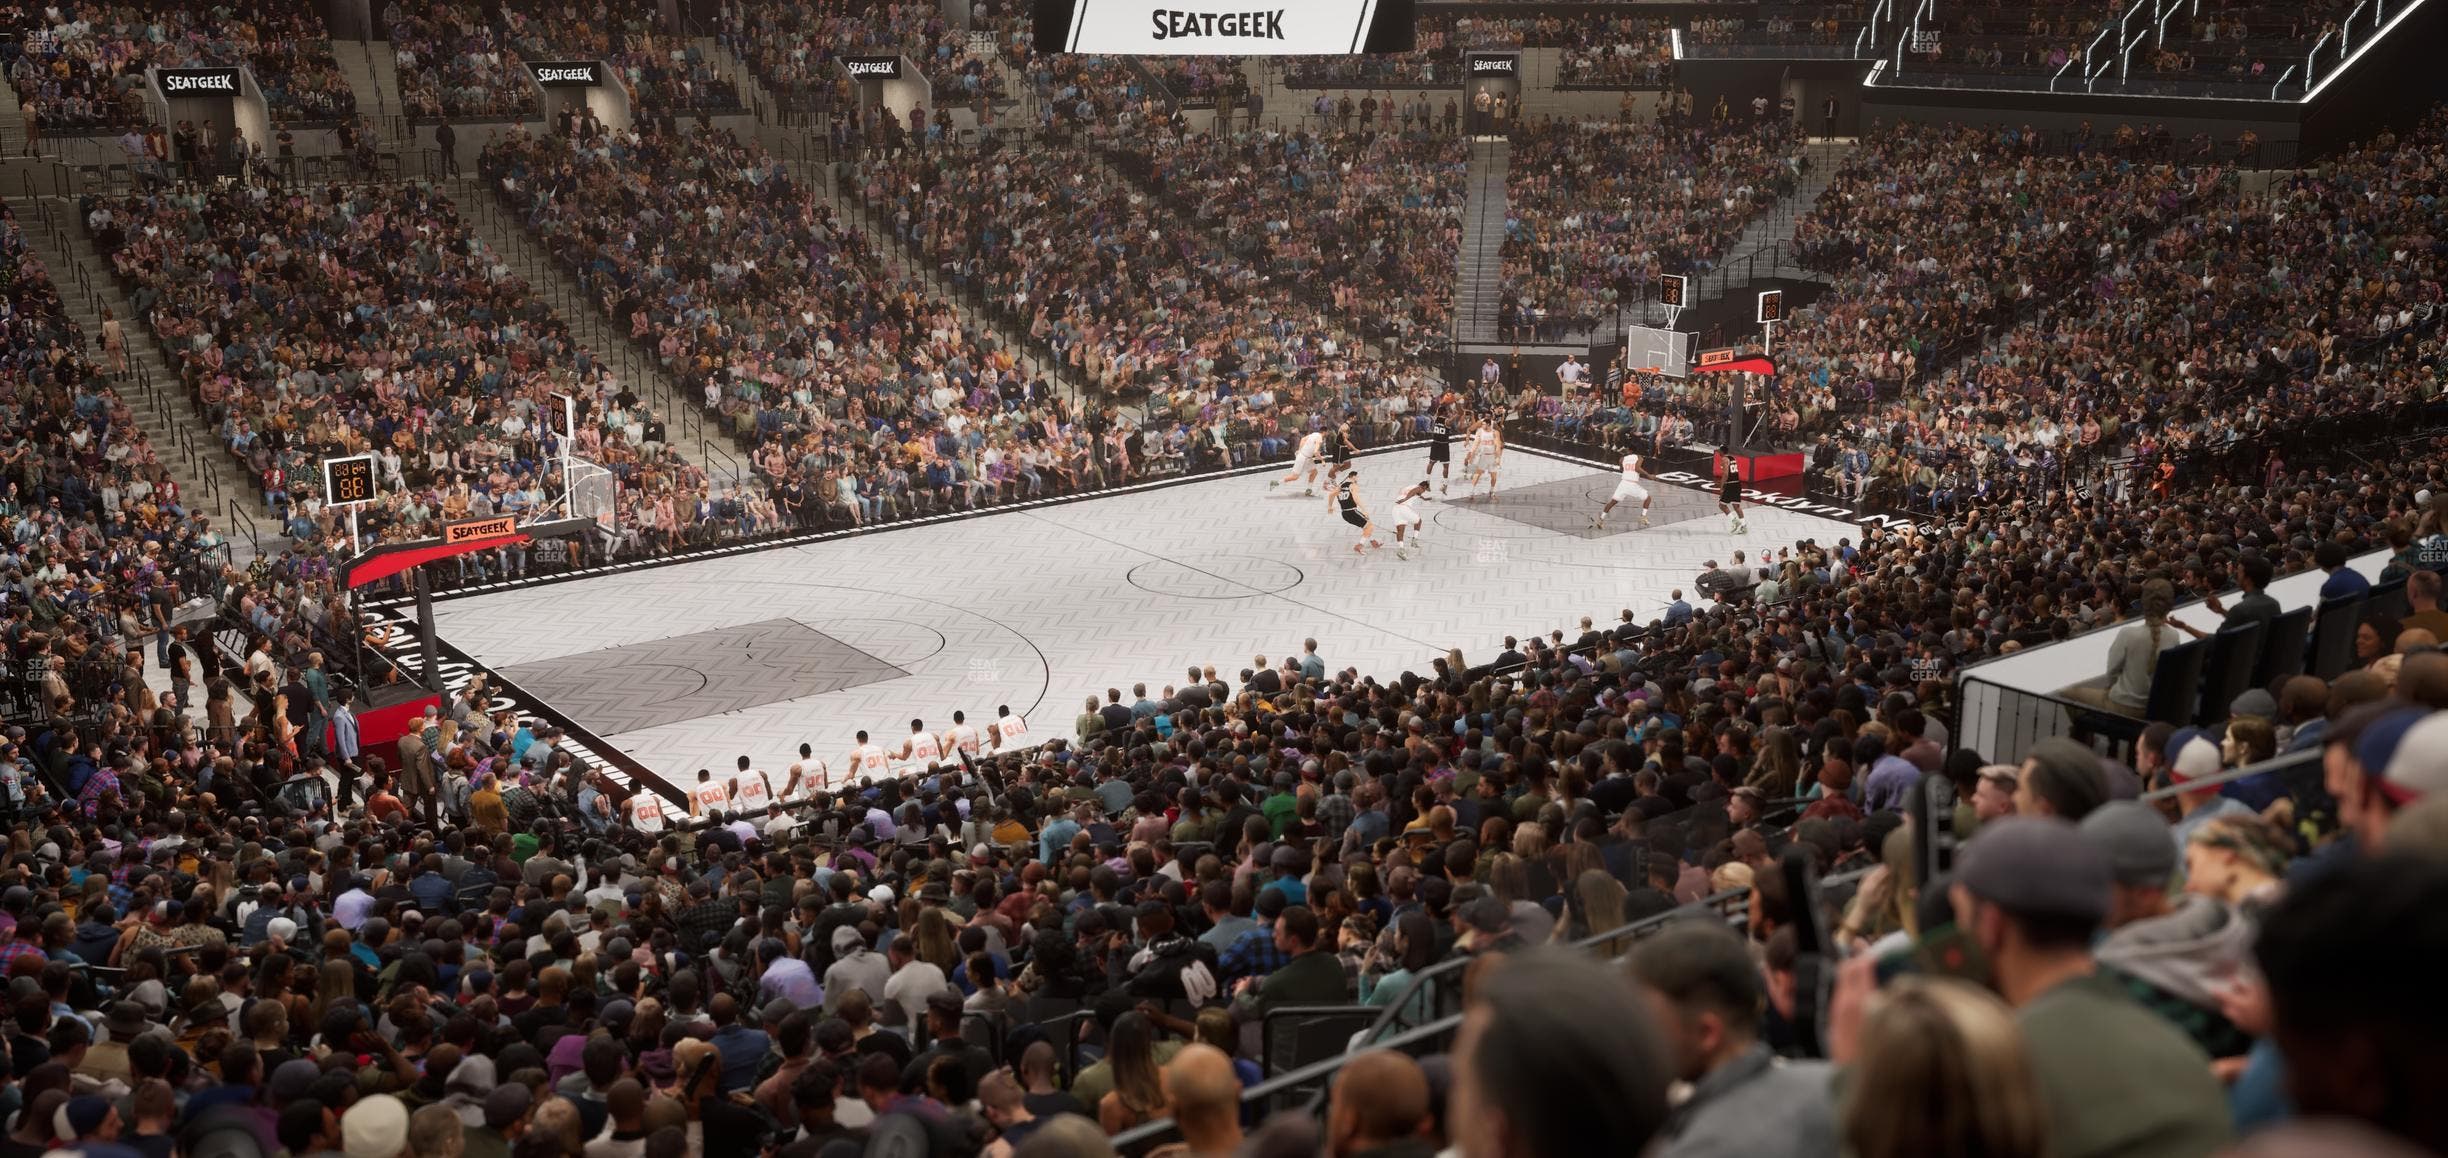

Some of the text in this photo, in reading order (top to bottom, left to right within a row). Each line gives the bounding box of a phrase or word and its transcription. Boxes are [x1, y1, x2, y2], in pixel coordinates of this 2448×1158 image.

[1152, 9, 1285, 40] SEATGEEK
[848, 61, 894, 74] SEATGEEK
[1474, 59, 1513, 71] SEATGEEK
[538, 66, 593, 82] SEATGEEK
[166, 74, 234, 91] SEATGEEK
[452, 521, 509, 540] SEATGEEK
